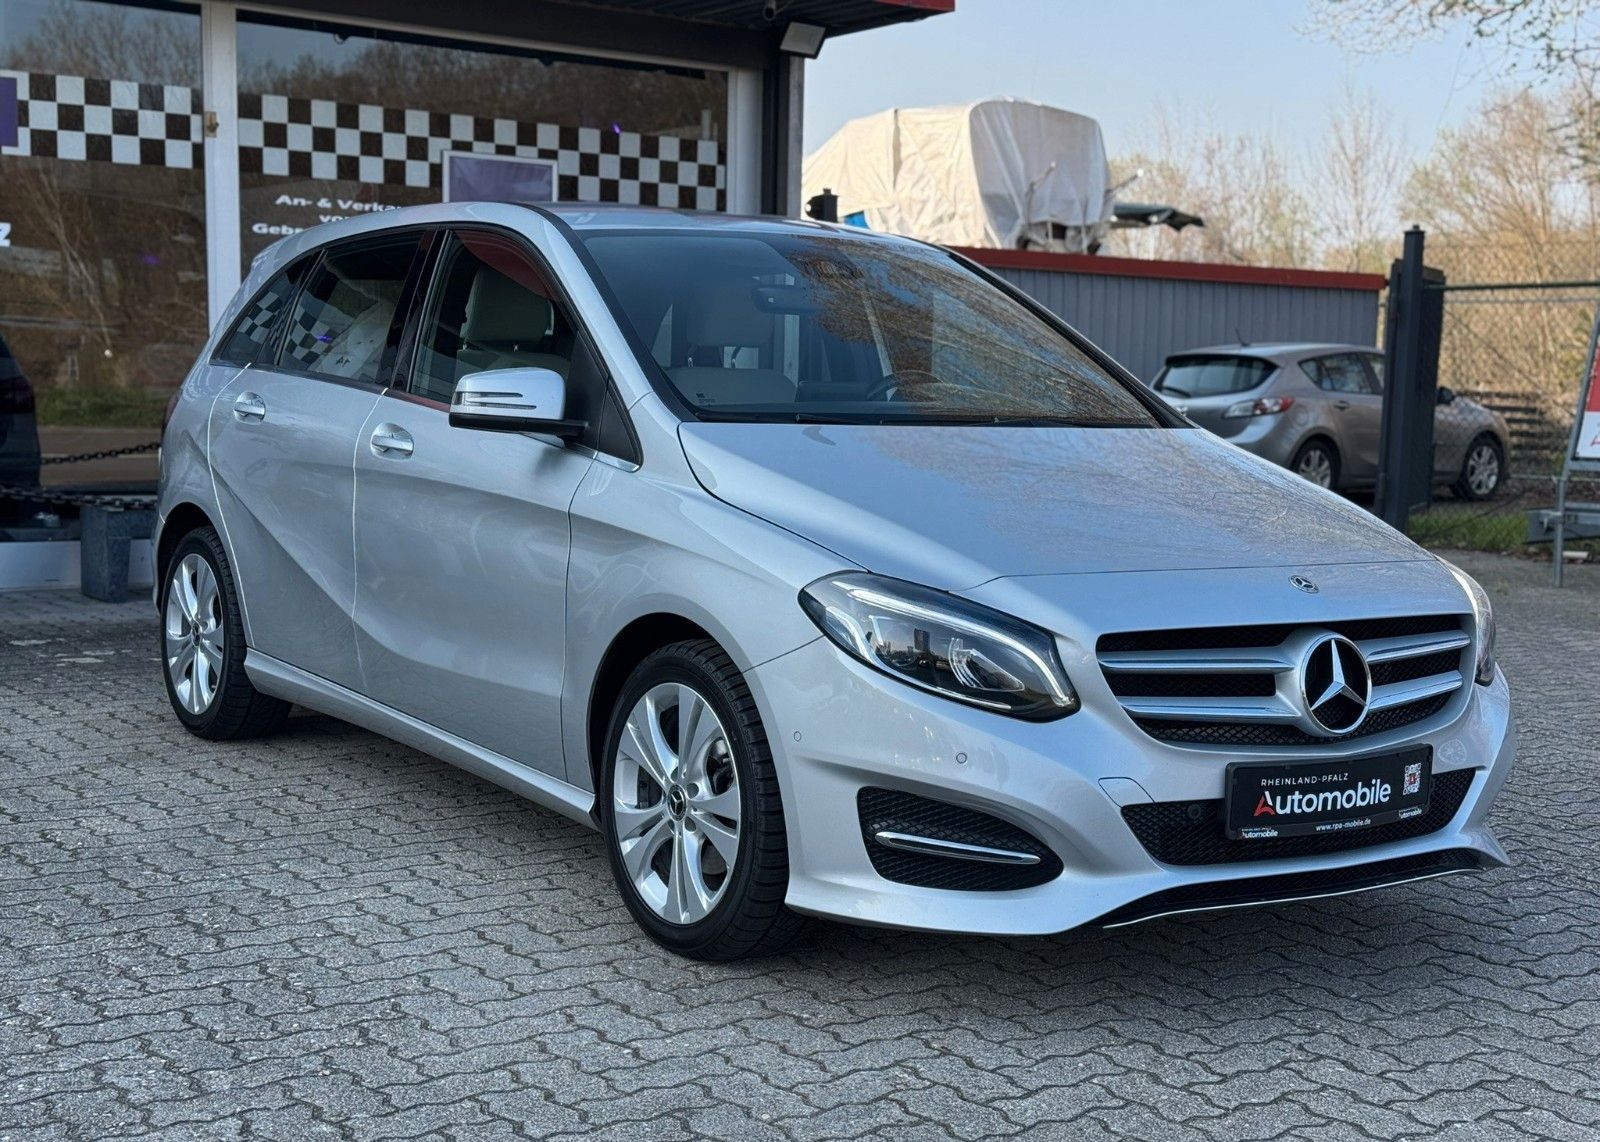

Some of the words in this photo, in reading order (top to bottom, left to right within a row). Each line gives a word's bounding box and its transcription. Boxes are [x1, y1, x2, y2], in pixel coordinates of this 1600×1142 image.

[275, 194, 312, 206] An-
[316, 197, 332, 209] &
[337, 199, 402, 212] Verka
[252, 222, 304, 235] Gebr
[1261, 773, 1349, 787] RHEINLAND-PFALZ
[1253, 779, 1392, 817] Automobile
[1315, 818, 1371, 831] www.rpa-mobile.de
